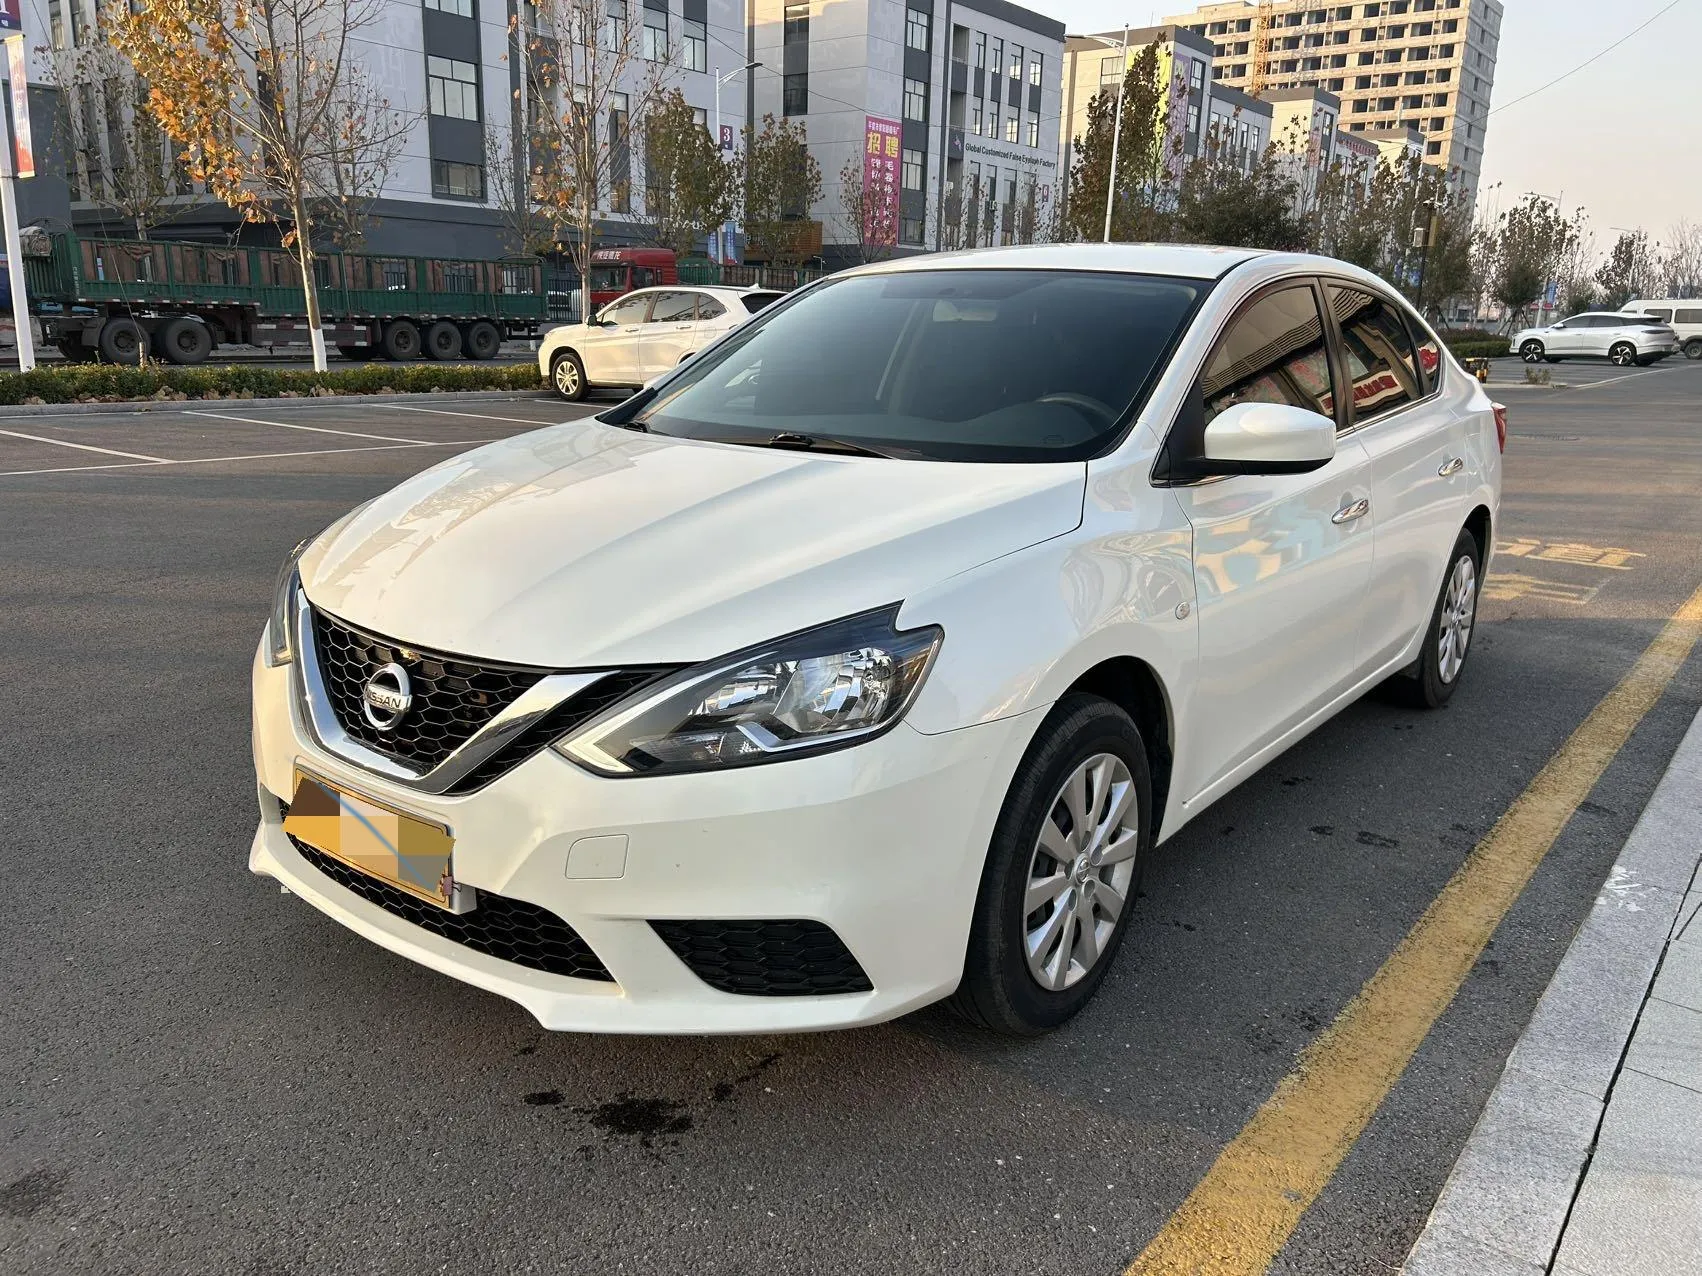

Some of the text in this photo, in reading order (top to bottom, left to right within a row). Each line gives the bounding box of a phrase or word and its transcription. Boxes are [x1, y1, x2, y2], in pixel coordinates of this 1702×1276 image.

[723, 127, 731, 142] 3
[867, 131, 899, 158] 招聘
[965, 142, 982, 155] Global
[982, 146, 1009, 160] Customized
[1009, 151, 1022, 162] False
[1040, 157, 1056, 170] Factory
